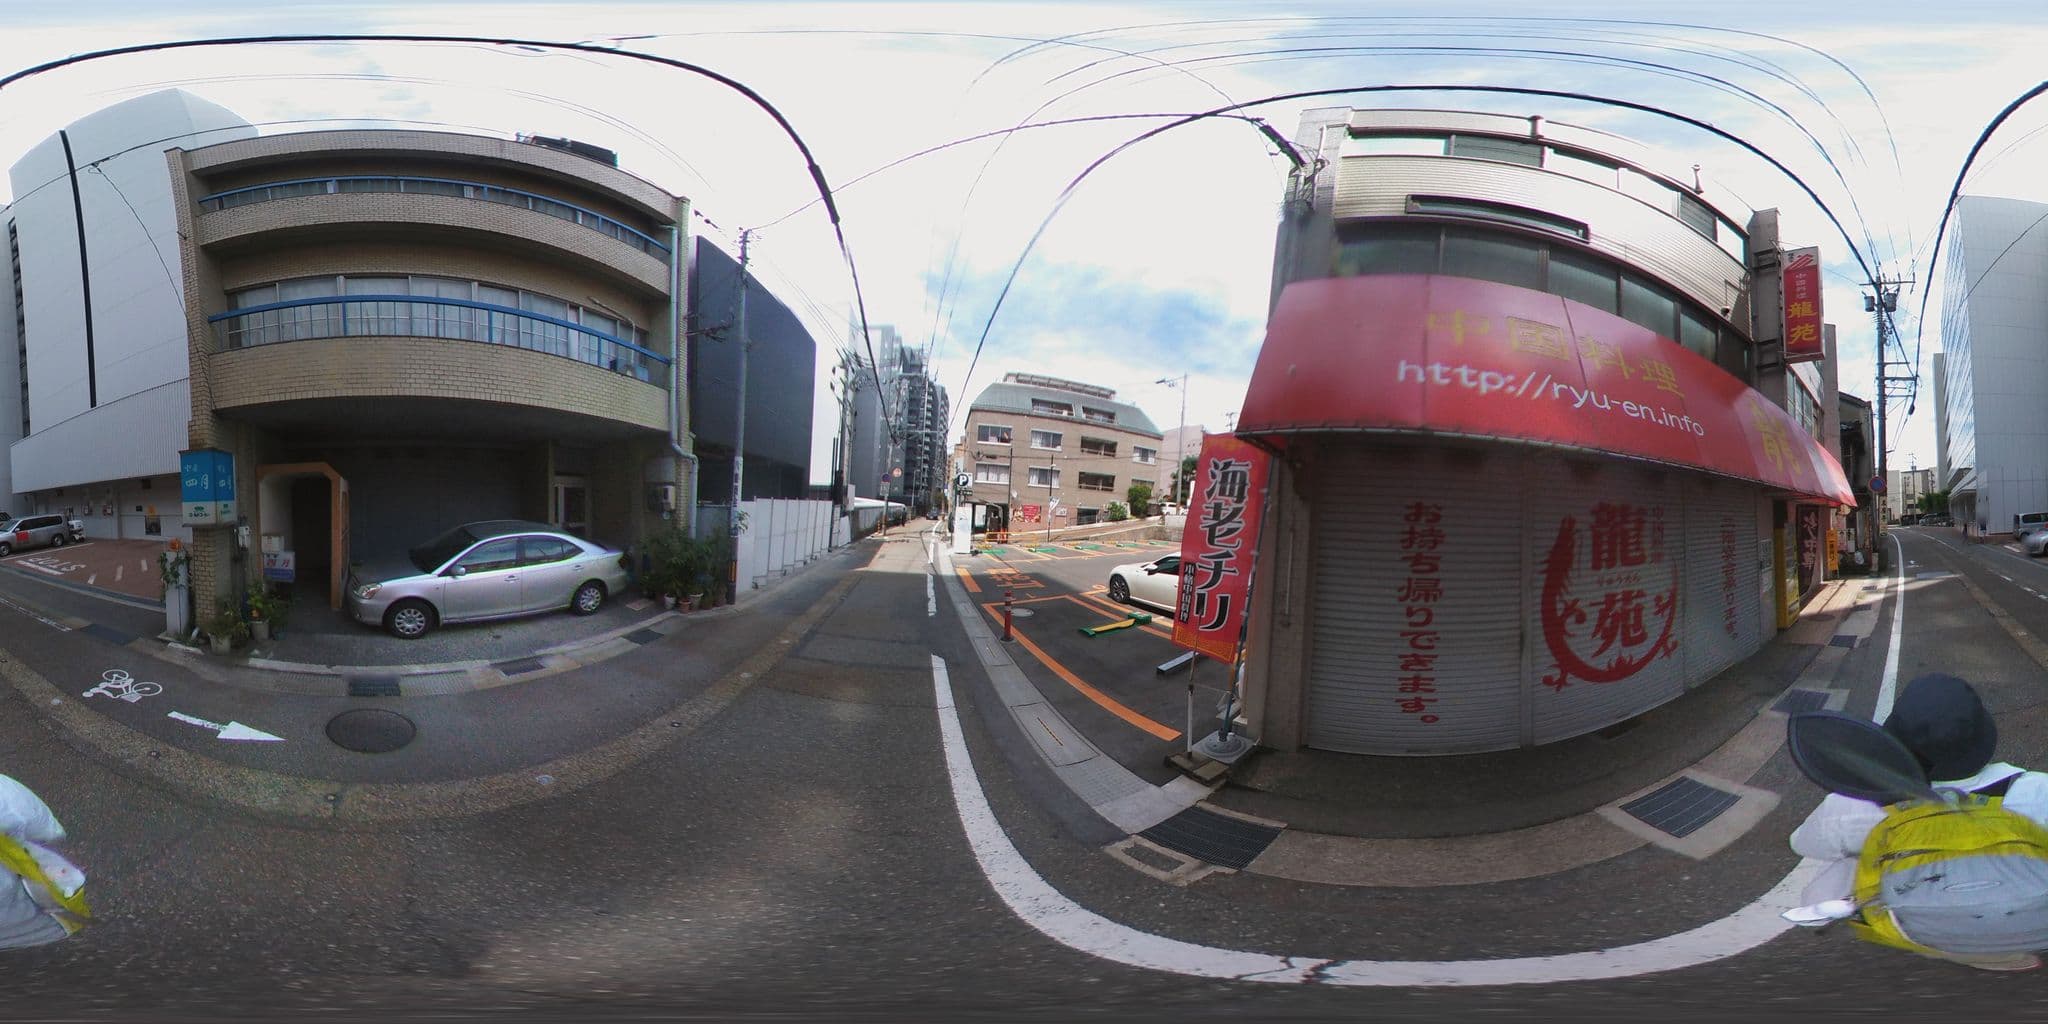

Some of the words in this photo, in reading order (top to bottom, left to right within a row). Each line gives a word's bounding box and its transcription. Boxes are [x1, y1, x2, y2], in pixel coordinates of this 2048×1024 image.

[1426, 309, 1684, 398] 中国料理
[1788, 302, 1817, 344] 龍苑
[1398, 359, 1705, 436] http://ryu-en.info
[1194, 457, 1251, 632] 海老チリ
[1590, 502, 1650, 659] 龍苑
[1395, 501, 1448, 724] お持ち帰りできます。
